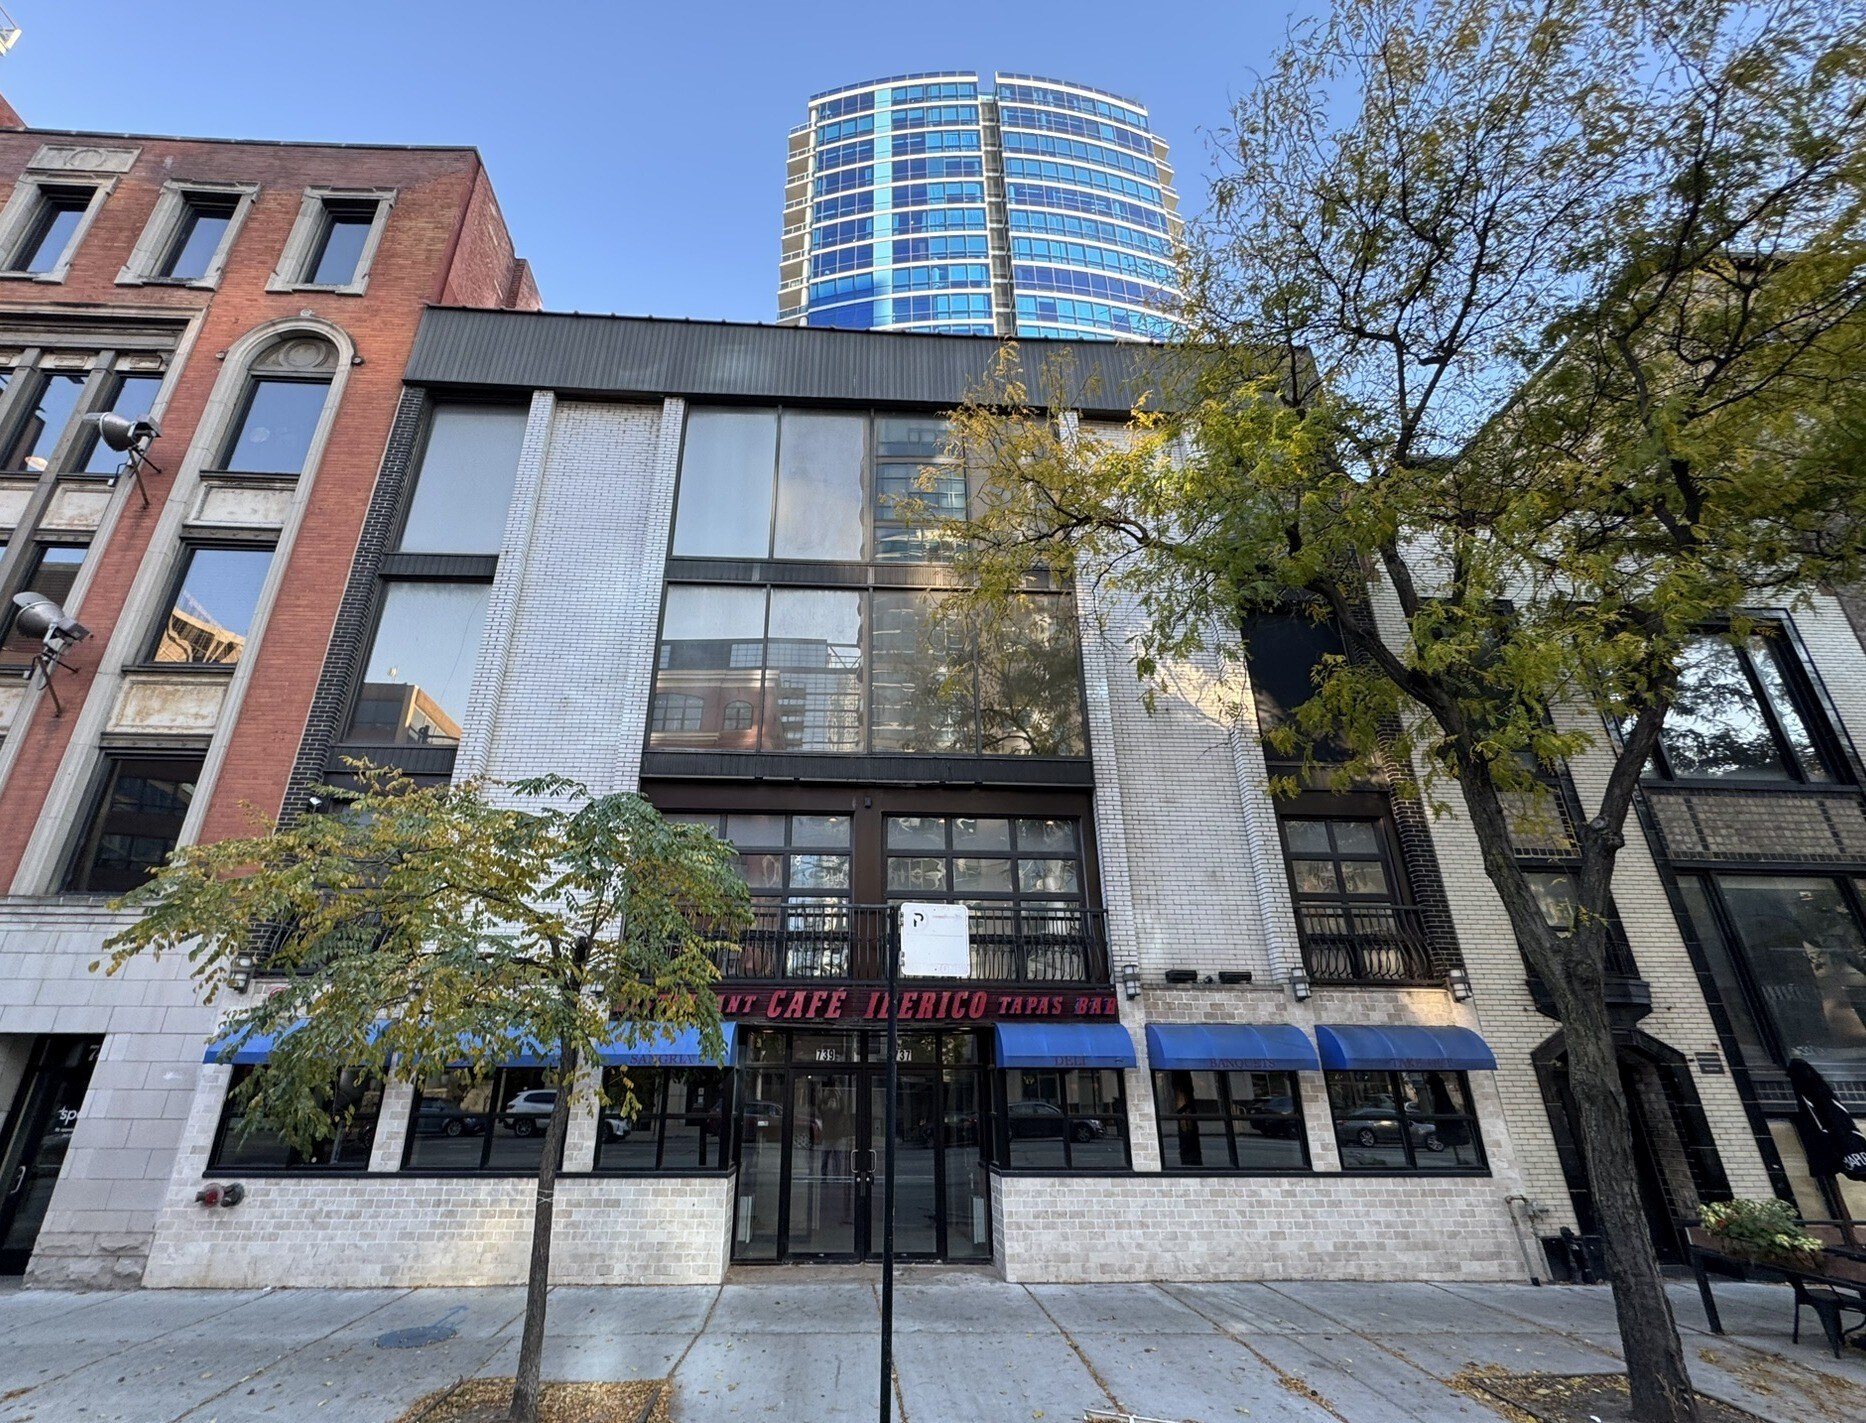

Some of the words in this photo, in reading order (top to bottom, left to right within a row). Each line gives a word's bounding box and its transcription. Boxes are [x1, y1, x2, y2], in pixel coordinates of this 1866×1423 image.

[766, 987, 847, 1018] CAFÉ
[999, 996, 1063, 1014] TAPAS
[1074, 997, 1116, 1014] BAR
[816, 1049, 835, 1061] 739
[896, 1050, 911, 1061] 37
[1055, 1056, 1086, 1066] DELI
